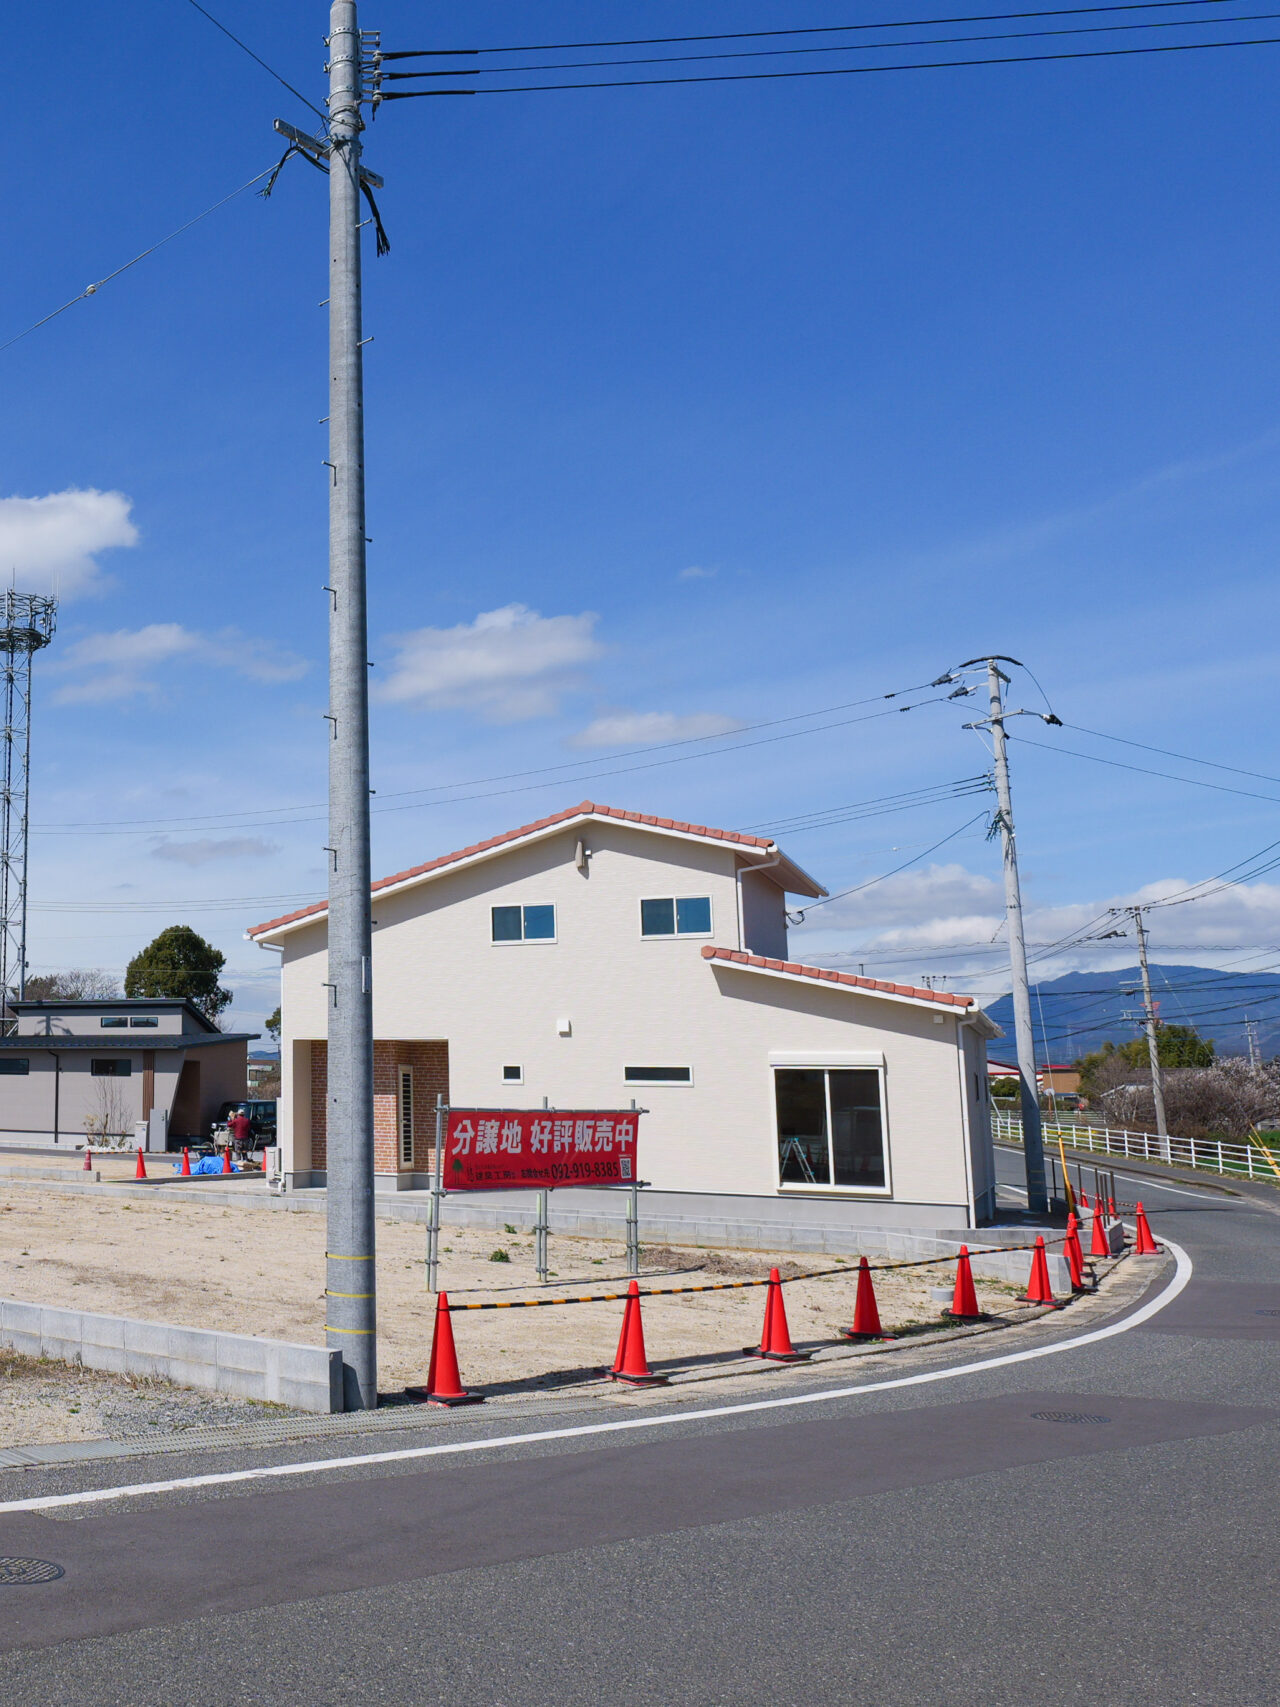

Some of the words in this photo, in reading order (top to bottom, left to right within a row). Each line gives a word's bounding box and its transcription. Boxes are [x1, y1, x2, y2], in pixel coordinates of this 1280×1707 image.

[451, 1119, 522, 1155] 分譲地
[530, 1119, 633, 1154] 好評販売中
[551, 1162, 619, 1179] 092-919-8385
